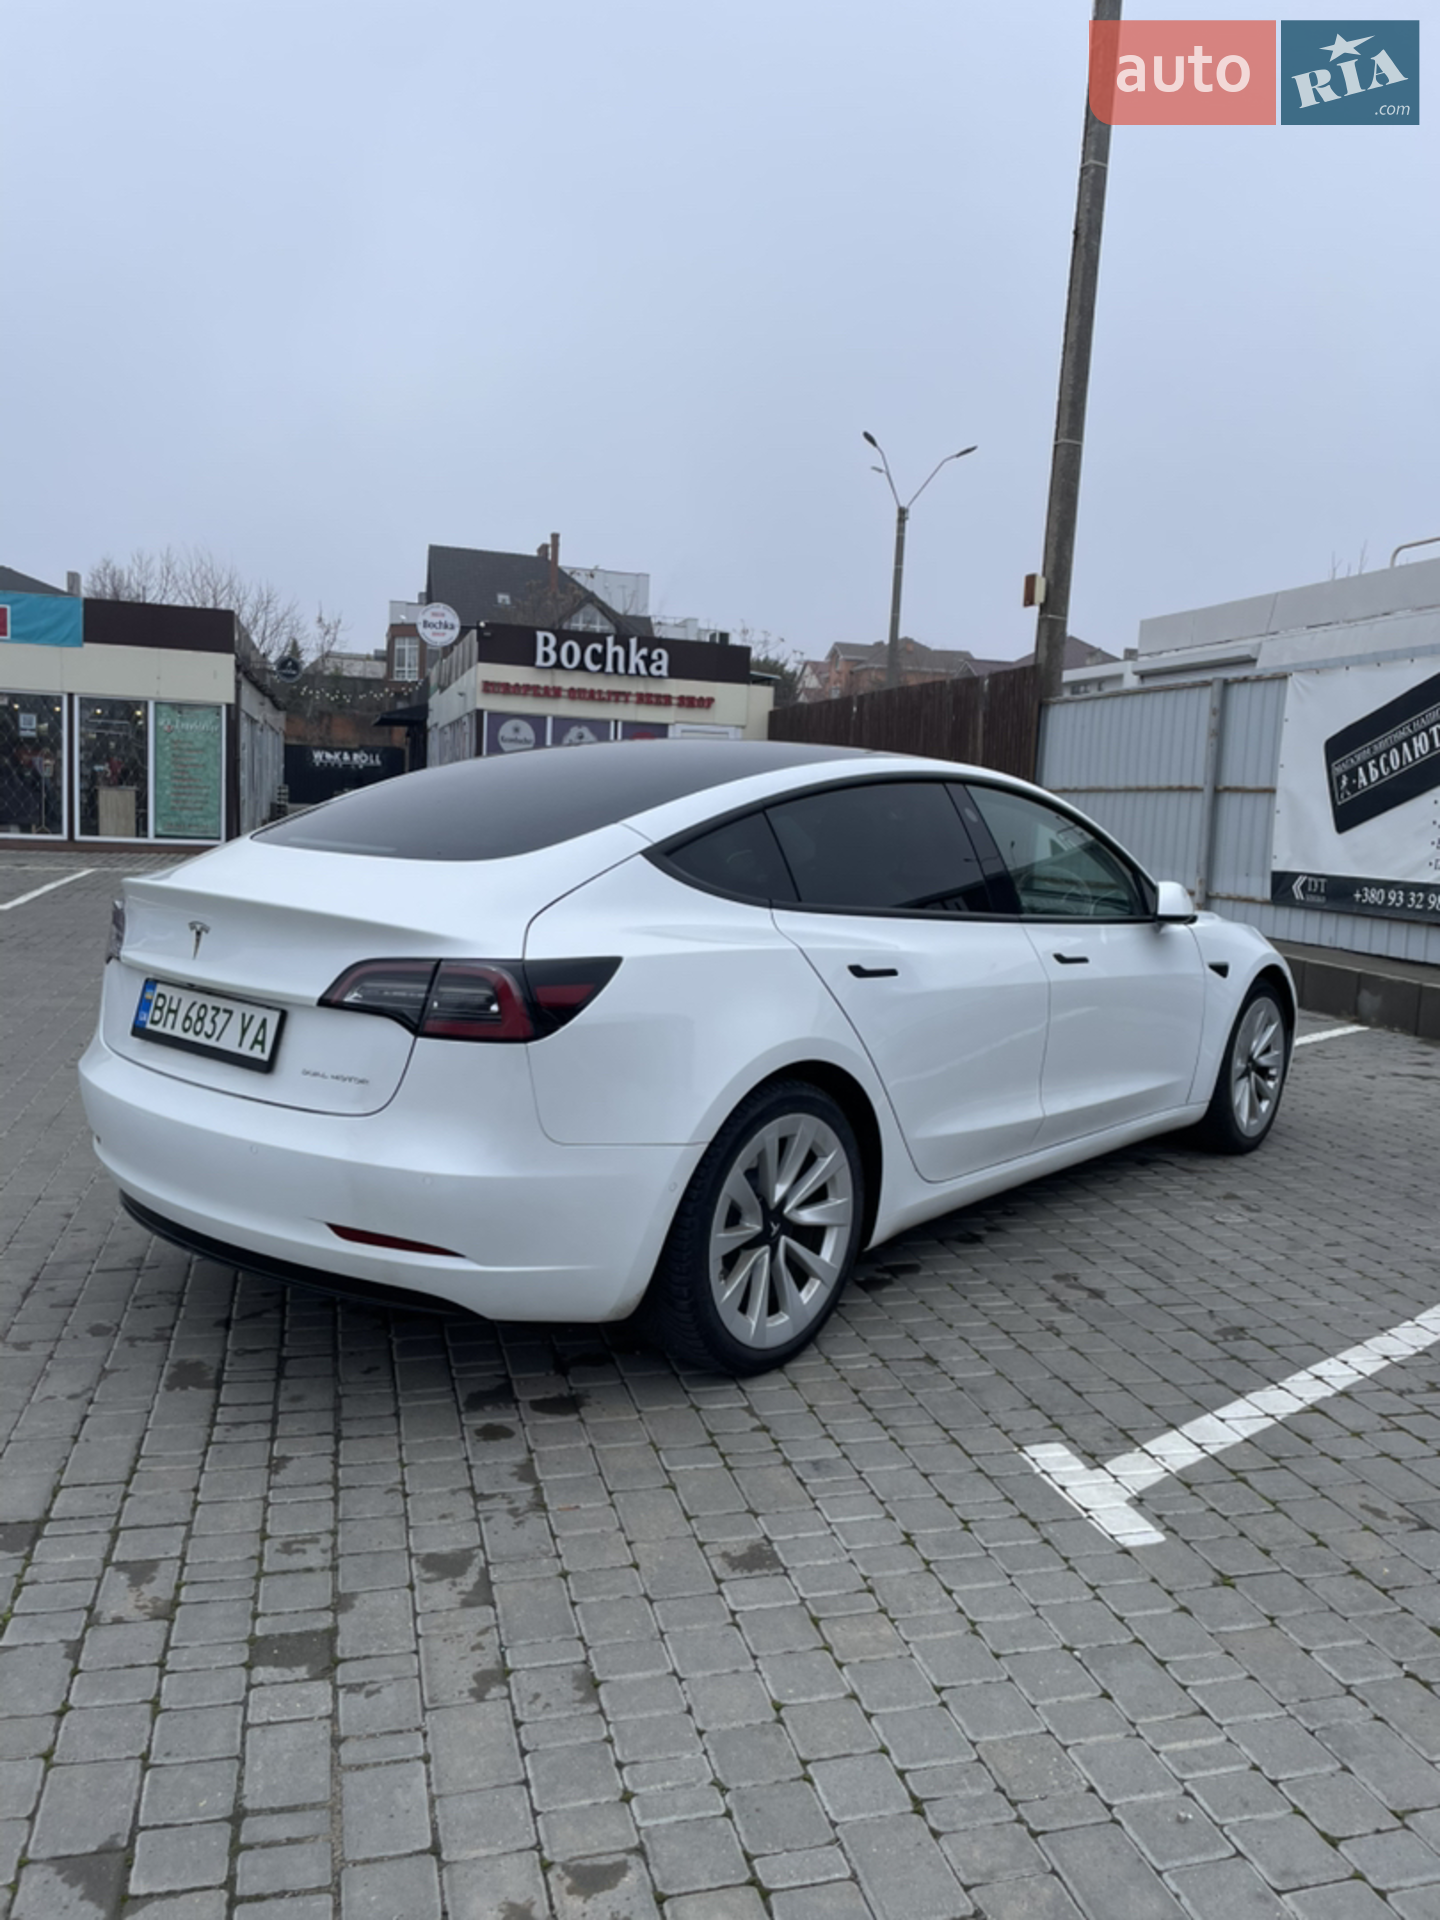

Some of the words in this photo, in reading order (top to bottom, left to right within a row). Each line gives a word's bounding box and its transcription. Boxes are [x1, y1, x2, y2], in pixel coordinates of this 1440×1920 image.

[422, 619, 455, 630] Bochka
[534, 630, 669, 678] Bochka
[481, 680, 562, 698] EUROPEAN
[568, 687, 632, 704] QUALITY
[635, 691, 673, 707] BEER
[676, 695, 716, 710] SHOP
[1357, 724, 1440, 789] АБСОЛЮТ
[1353, 887, 1385, 905] +380
[1387, 889, 1404, 907] 93
[1407, 891, 1424, 909] 32
[149, 992, 182, 1031] BH
[181, 1001, 234, 1042] 6837
[237, 1012, 268, 1054] YA
